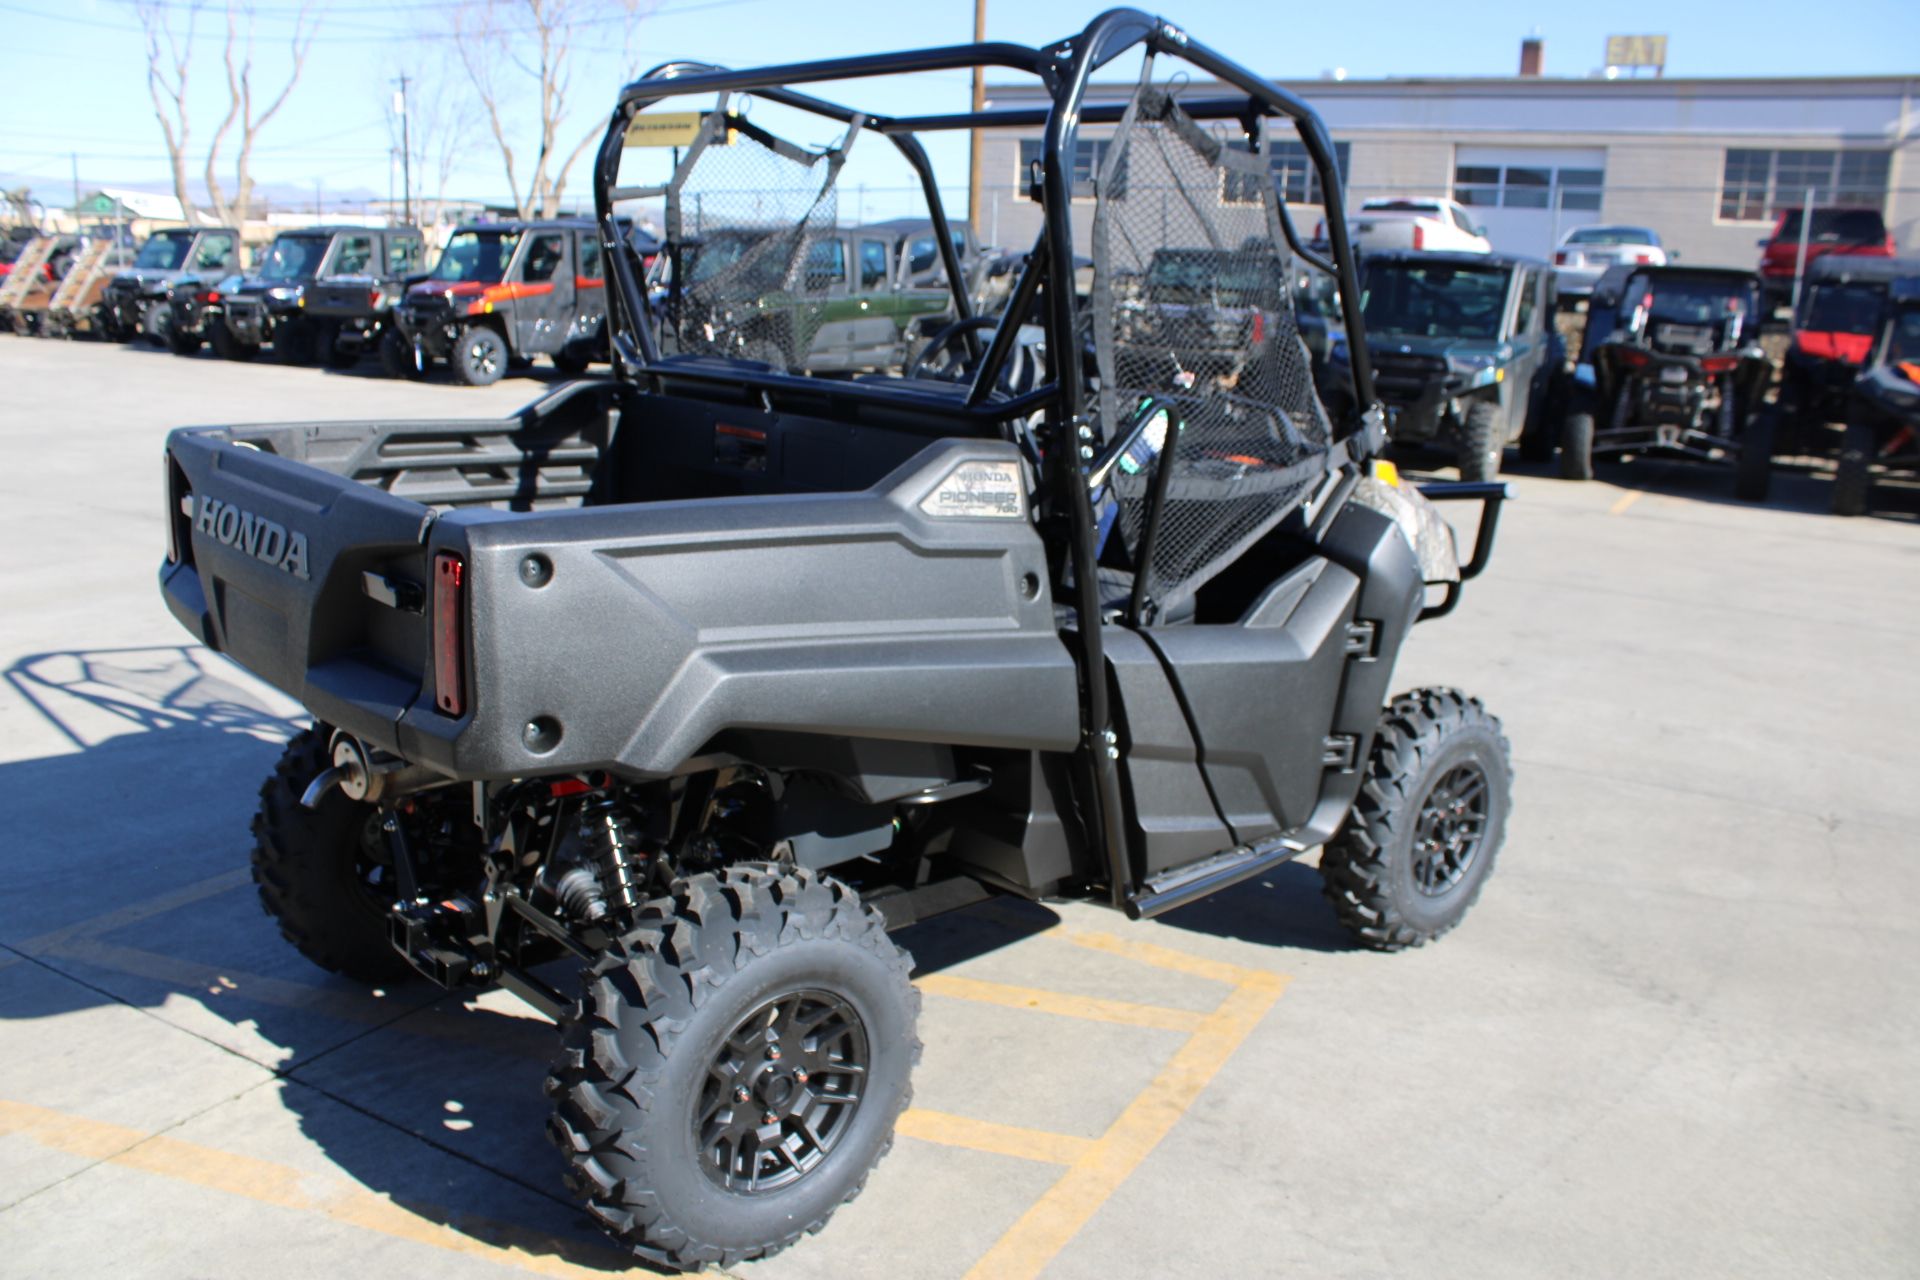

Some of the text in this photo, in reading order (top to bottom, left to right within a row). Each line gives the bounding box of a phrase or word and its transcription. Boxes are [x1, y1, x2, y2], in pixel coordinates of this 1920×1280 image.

[1607, 35, 1666, 65] EAT
[964, 471, 1012, 482] HONDA
[940, 491, 1017, 503] PIONEER
[995, 504, 1017, 513] 700
[196, 495, 310, 581] HONDA
